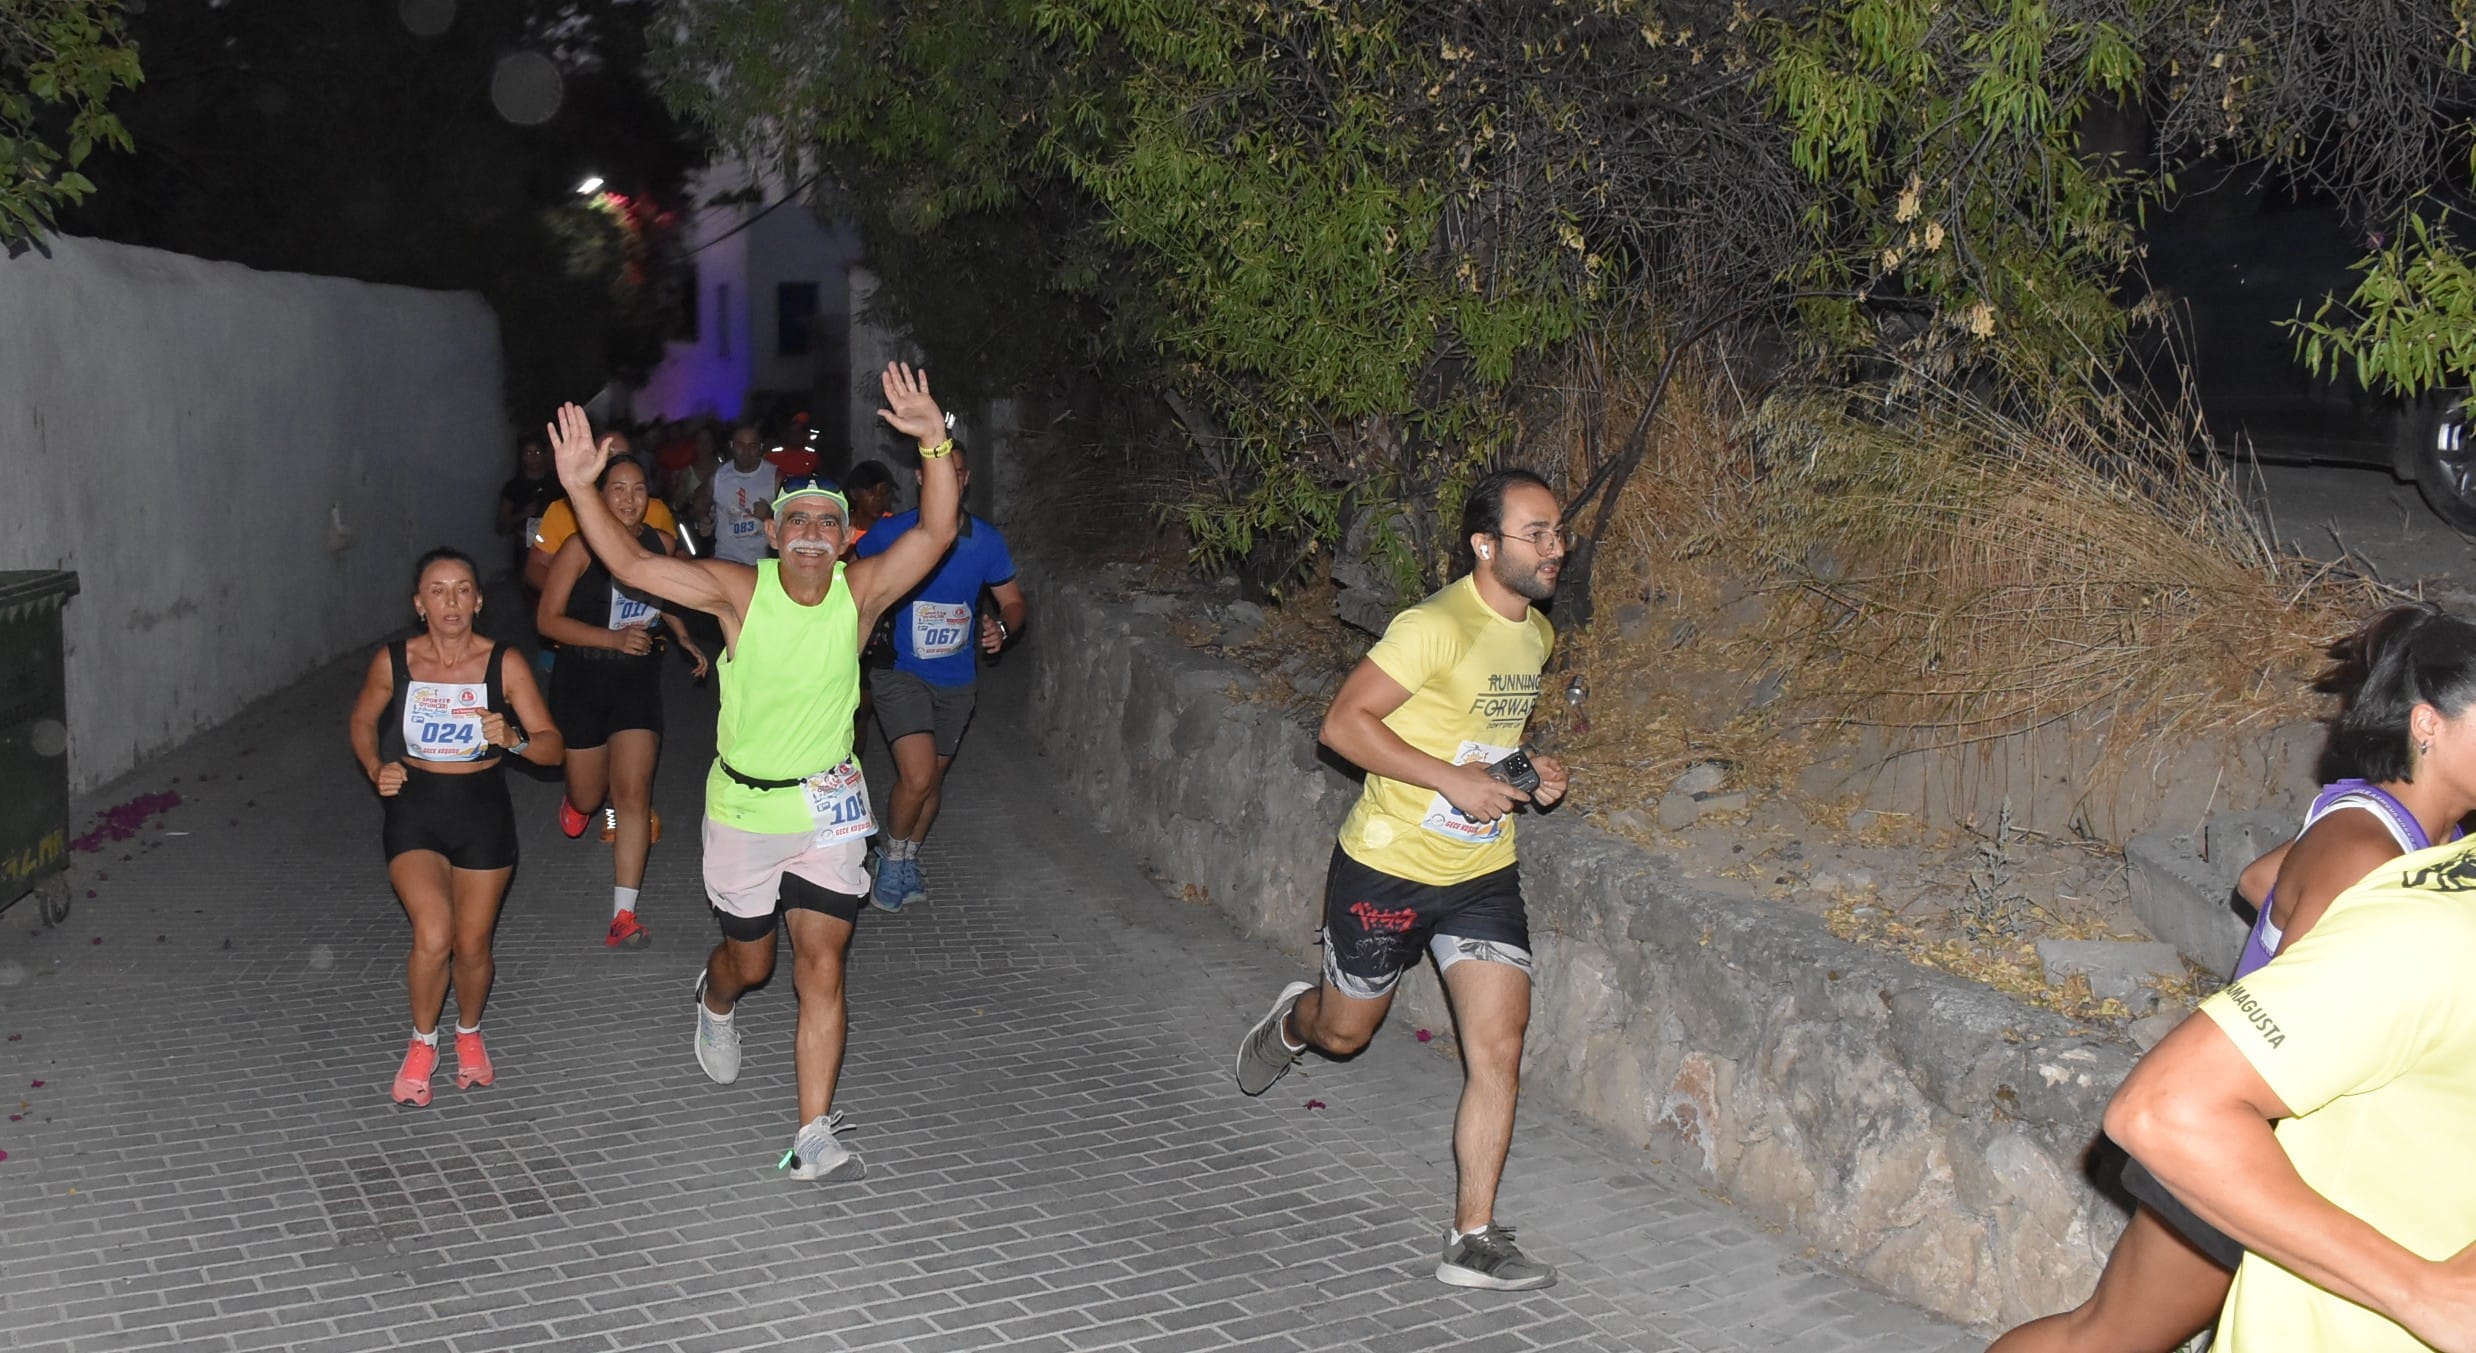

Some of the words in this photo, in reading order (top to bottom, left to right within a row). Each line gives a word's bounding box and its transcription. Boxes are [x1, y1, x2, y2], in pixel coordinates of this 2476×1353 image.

[733, 521, 755, 534] 083
[621, 600, 649, 619] 017
[925, 628, 960, 645] 067
[1487, 673, 1541, 692] RUNNING
[421, 722, 474, 744] 024
